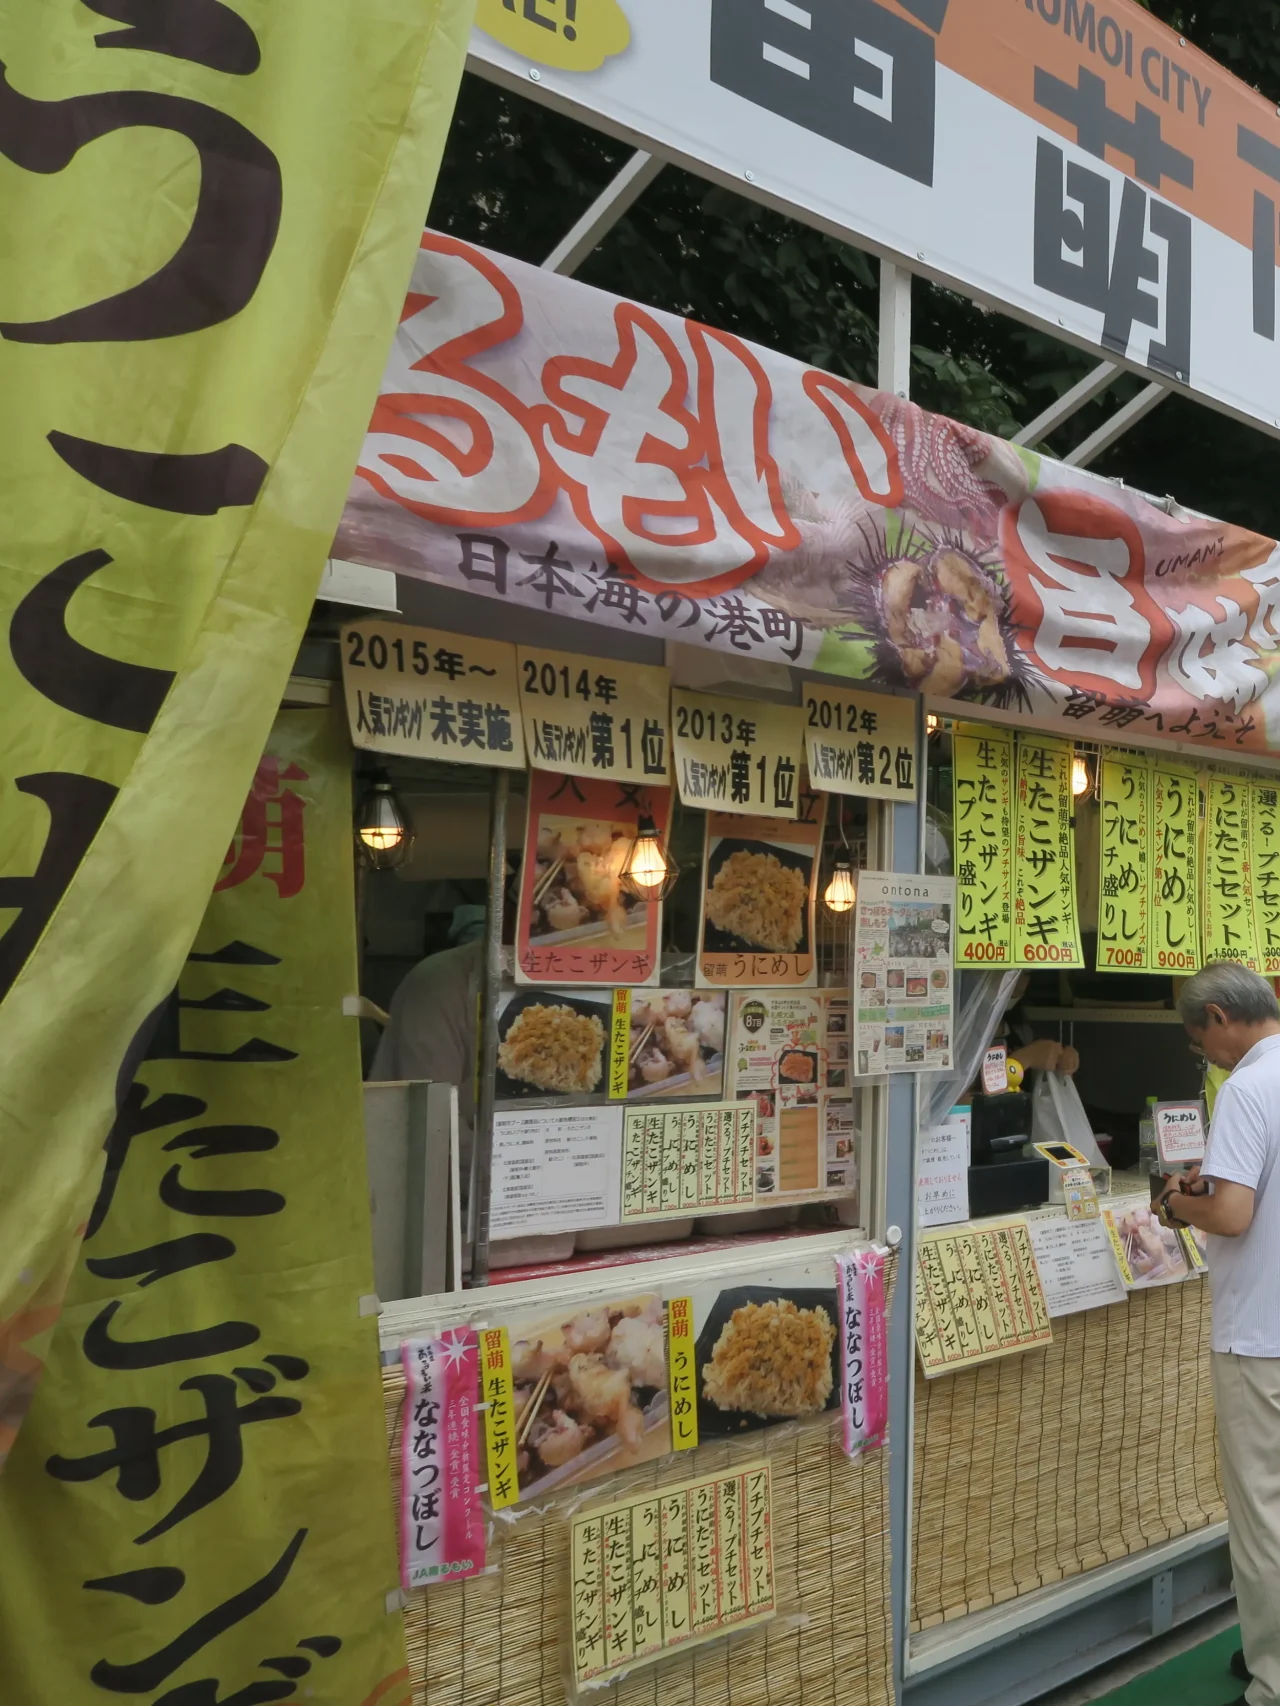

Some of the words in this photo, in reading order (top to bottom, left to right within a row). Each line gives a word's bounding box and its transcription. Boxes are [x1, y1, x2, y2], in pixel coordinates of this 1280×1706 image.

[1140, 46, 1212, 127] CITY
[355, 231, 905, 597] るもい
[457, 530, 811, 664] 日本海の港町
[1155, 537, 1224, 577] UMAMI
[523, 657, 618, 706] 2014年
[806, 697, 878, 736] 2012年
[1062, 685, 1256, 744] 留萌へようこそ
[676, 705, 758, 748] 2013年
[976, 741, 999, 942] 生たこザンギ
[1026, 751, 1059, 945] 生たこザンギ
[1119, 767, 1139, 940] うにめし
[1162, 777, 1186, 947] うにめし
[1213, 783, 1241, 945] うにたこセット
[881, 884, 929, 897] ontona
[521, 950, 651, 979] 生たこザンギ
[733, 953, 810, 979] うにめし
[964, 942, 1005, 961] 400円
[1023, 944, 1073, 962] 600円
[1106, 947, 1143, 966] 700円
[1158, 950, 1195, 969] 900円
[615, 989, 629, 1014] 留萌
[612, 1017, 627, 1094] 生たこザンギ
[630, 1118, 642, 1198] 生たこザンギ
[647, 1117, 660, 1204] 生たこザンギ
[668, 1116, 678, 1193] うにめし
[684, 1114, 696, 1199] うにめし
[704, 1112, 714, 1194] うにたこセット
[740, 1110, 750, 1191] プチプチセット
[1163, 1112, 1197, 1124] うにめし
[670, 1298, 691, 1338] 留萌
[922, 1246, 957, 1350] 生たこザンギ
[962, 1240, 994, 1340] うにめし
[981, 1235, 1010, 1332] うにたこセット
[1015, 1228, 1043, 1325] プチプチセット
[485, 1329, 505, 1371] 留萌
[846, 1306, 865, 1429] ななつぼし
[672, 1350, 694, 1440] うにめし
[411, 1398, 441, 1552] ななつぼし
[487, 1377, 514, 1501] 生たこザンギ
[642, 1507, 659, 1628] うにめし
[667, 1499, 686, 1630] うにめし
[696, 1488, 712, 1615] うにたこセット
[750, 1471, 765, 1597] プチプチセット
[582, 1525, 600, 1651] 生たこザンギ
[608, 1516, 628, 1652] 生たこザンギ
